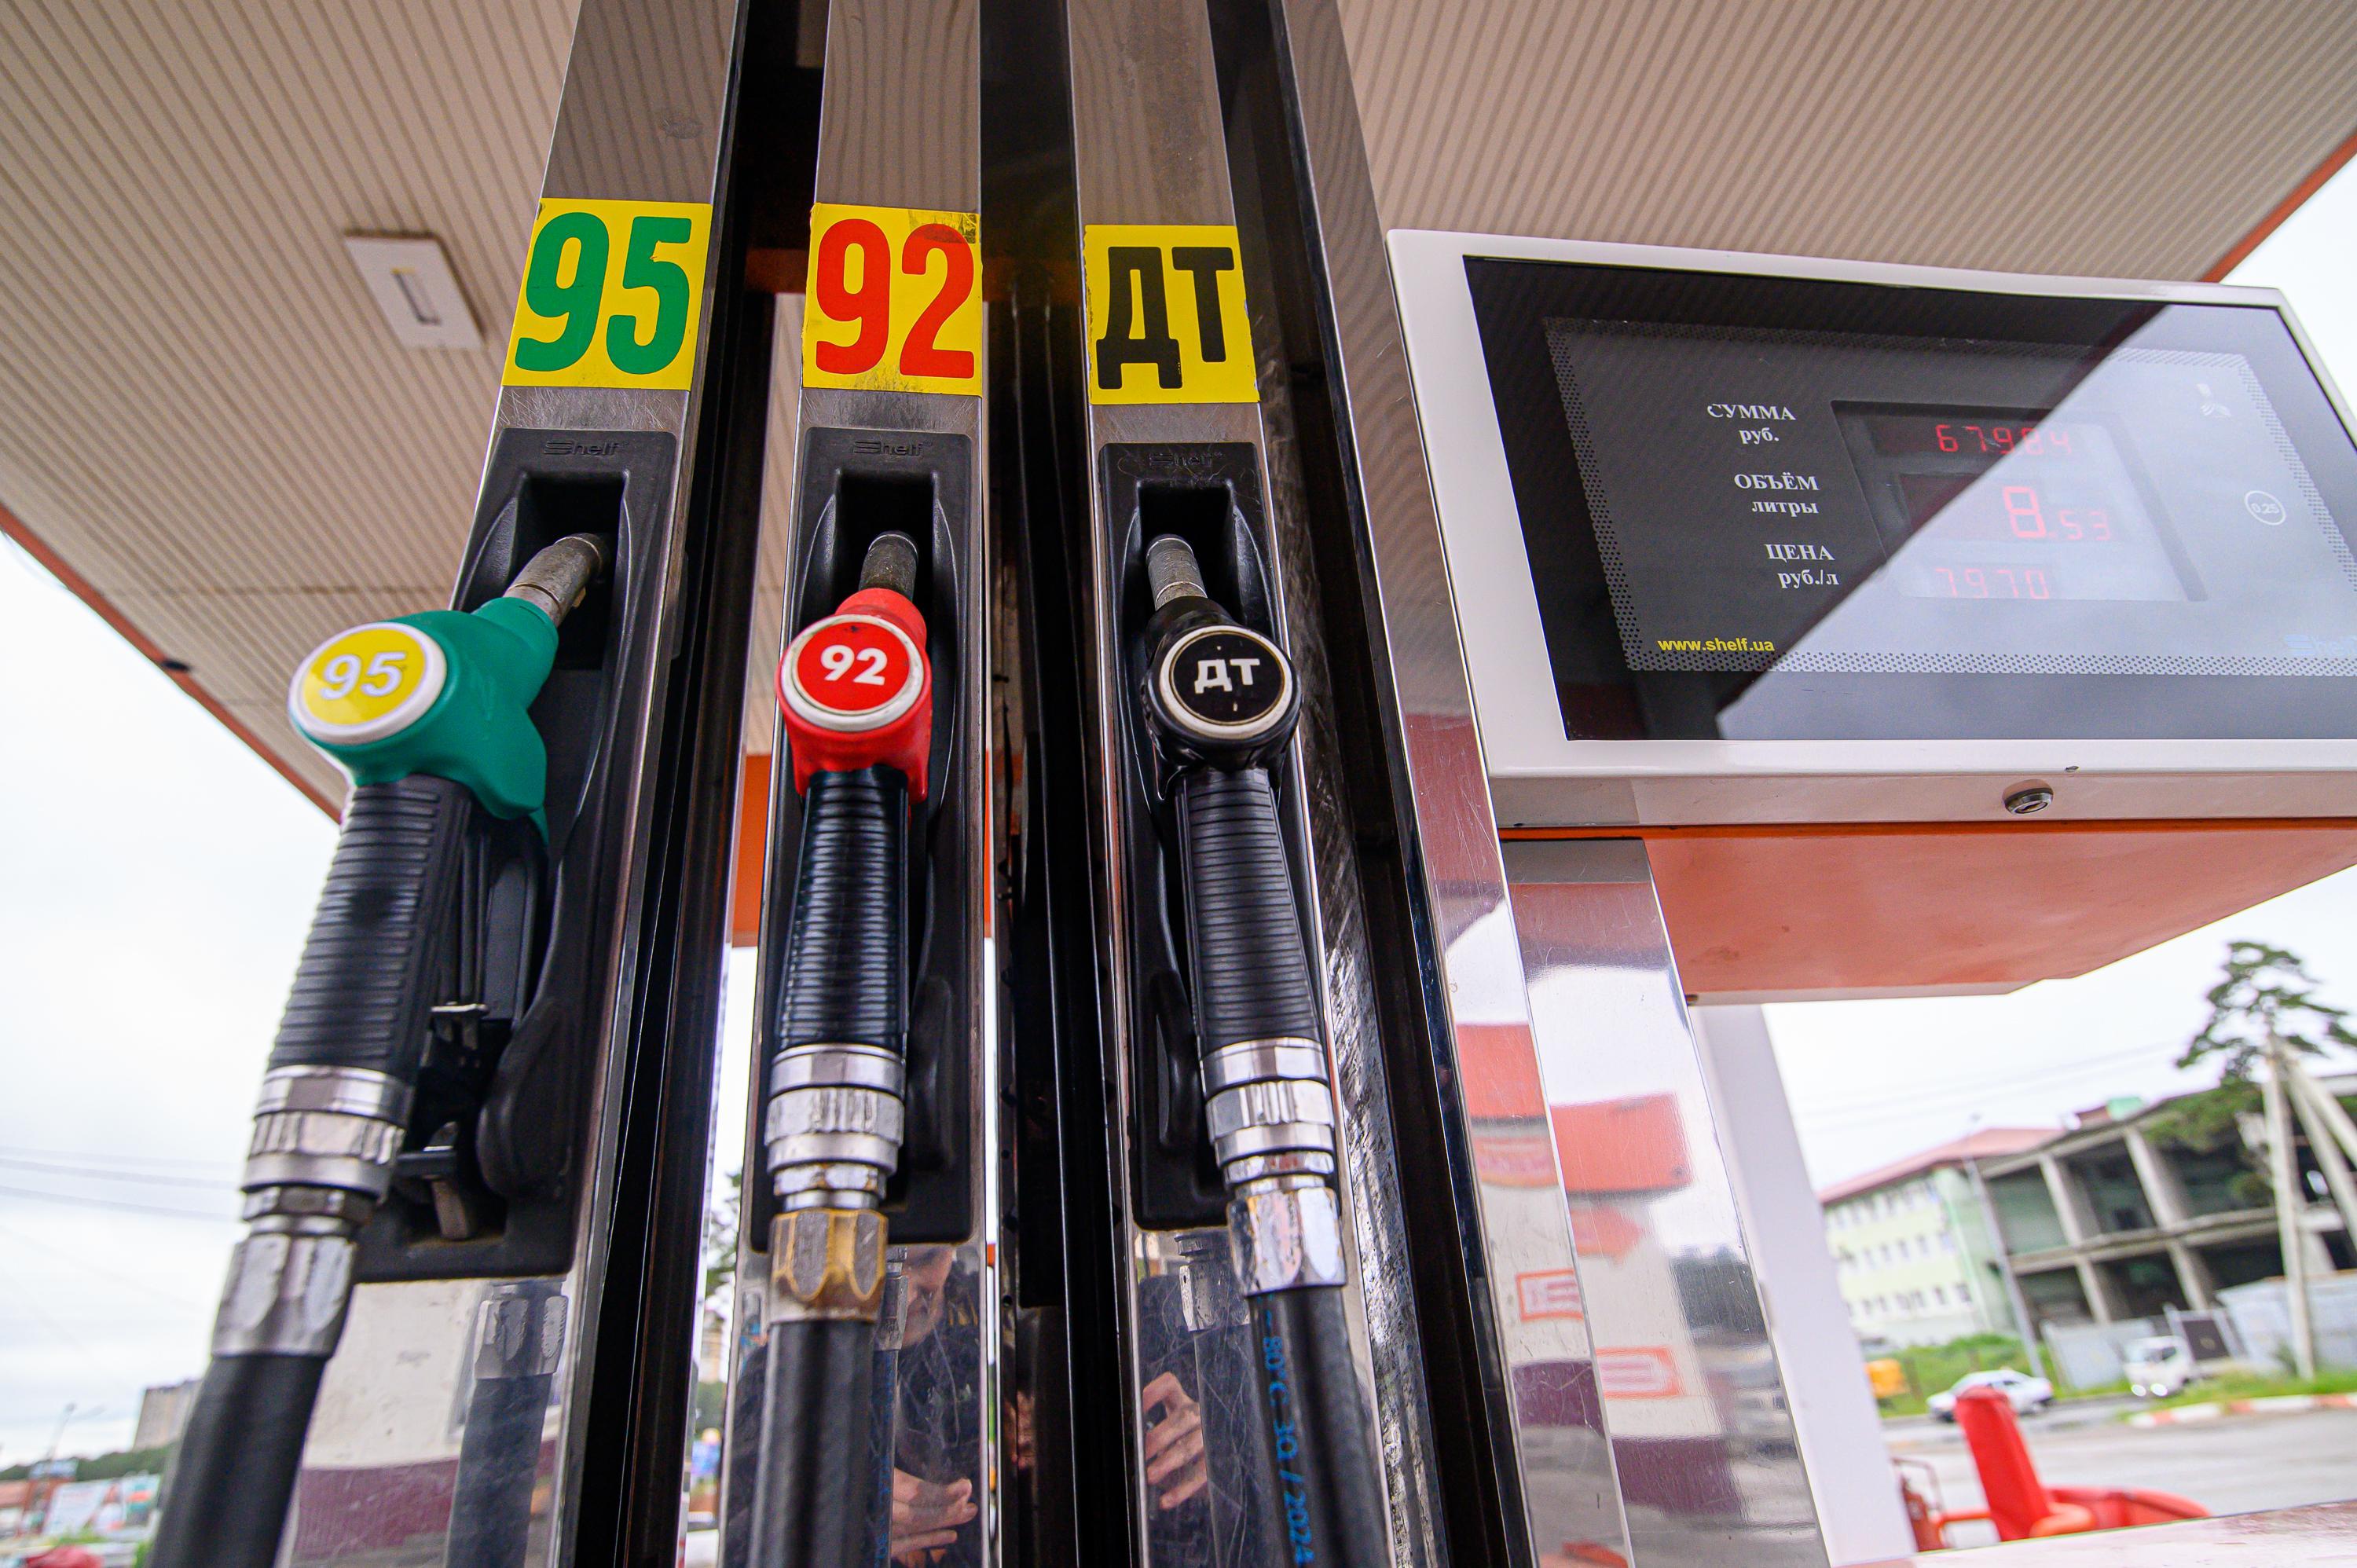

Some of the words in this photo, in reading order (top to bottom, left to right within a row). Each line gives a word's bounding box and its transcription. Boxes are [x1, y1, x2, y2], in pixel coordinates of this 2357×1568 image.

[515, 211, 692, 376] 95
[815, 218, 976, 379] 92
[1097, 247, 1234, 390] ДТ
[1706, 403, 1797, 421] СУММА
[1739, 427, 1780, 445] руб.
[1734, 472, 1820, 490] ОБЪЁМ
[1752, 500, 1819, 518] литры
[1765, 544, 1835, 562] ЦЕНА
[1778, 570, 1840, 589] руб./л
[1657, 637, 1776, 652] www.shelf.ua
[820, 644, 888, 687] 92
[320, 651, 408, 701] 95
[1194, 658, 1261, 694] ДТ
